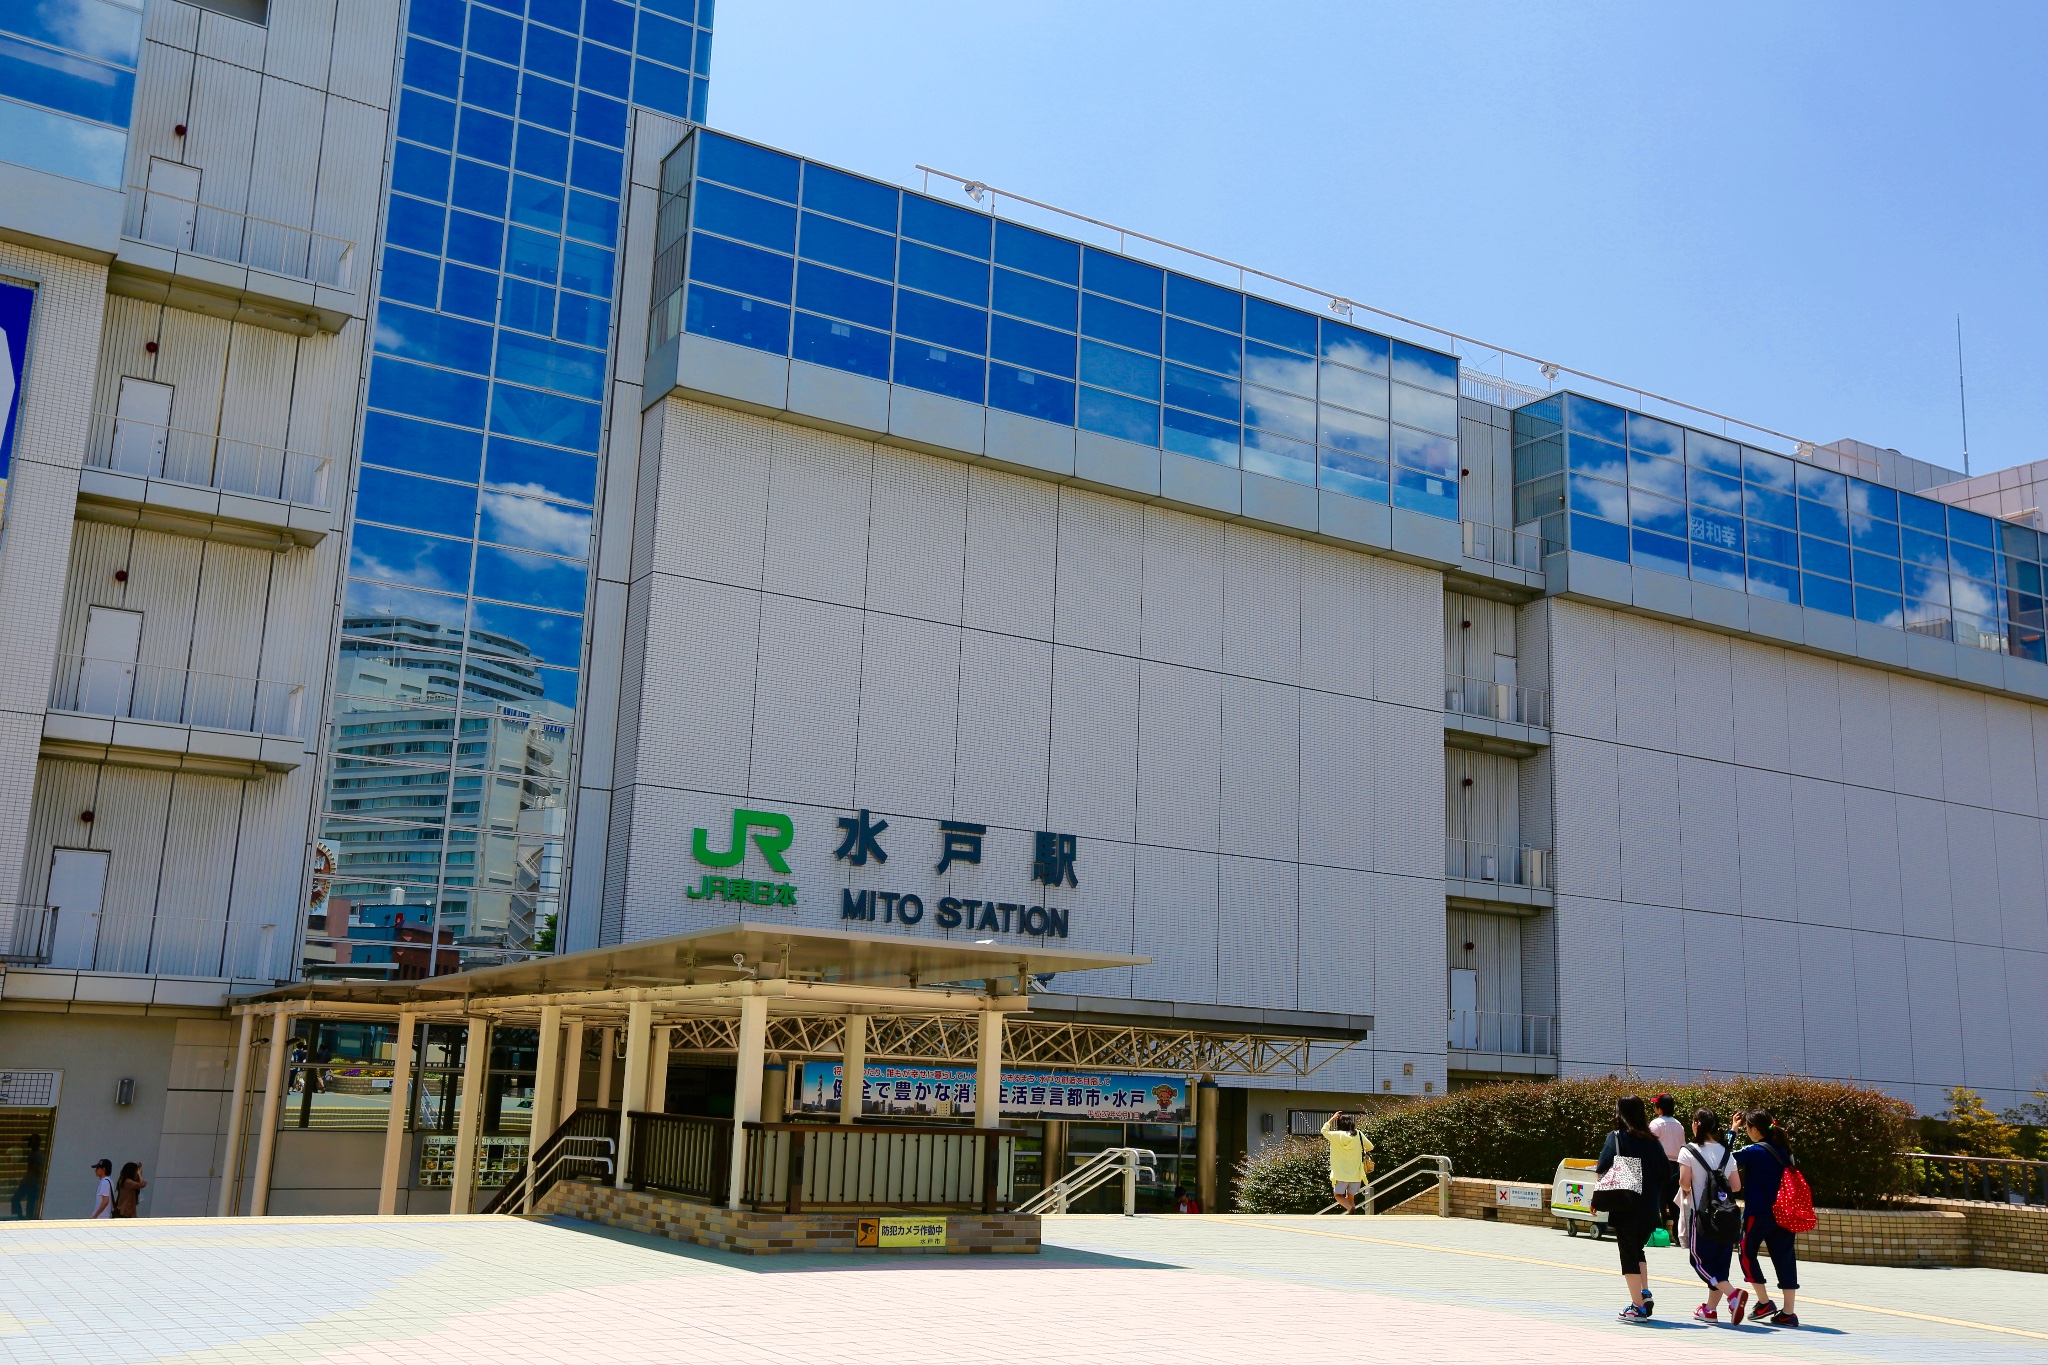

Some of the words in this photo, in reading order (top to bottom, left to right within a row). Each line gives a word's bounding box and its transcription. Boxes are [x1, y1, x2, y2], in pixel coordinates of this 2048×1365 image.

[692, 808, 794, 874] JR
[833, 809, 1079, 888] 水戸駅
[687, 876, 798, 907] JR東日本
[842, 888, 924, 924] MITO
[936, 897, 1070, 938] STATION
[882, 1225, 943, 1236] 防犯カメラ作動中
